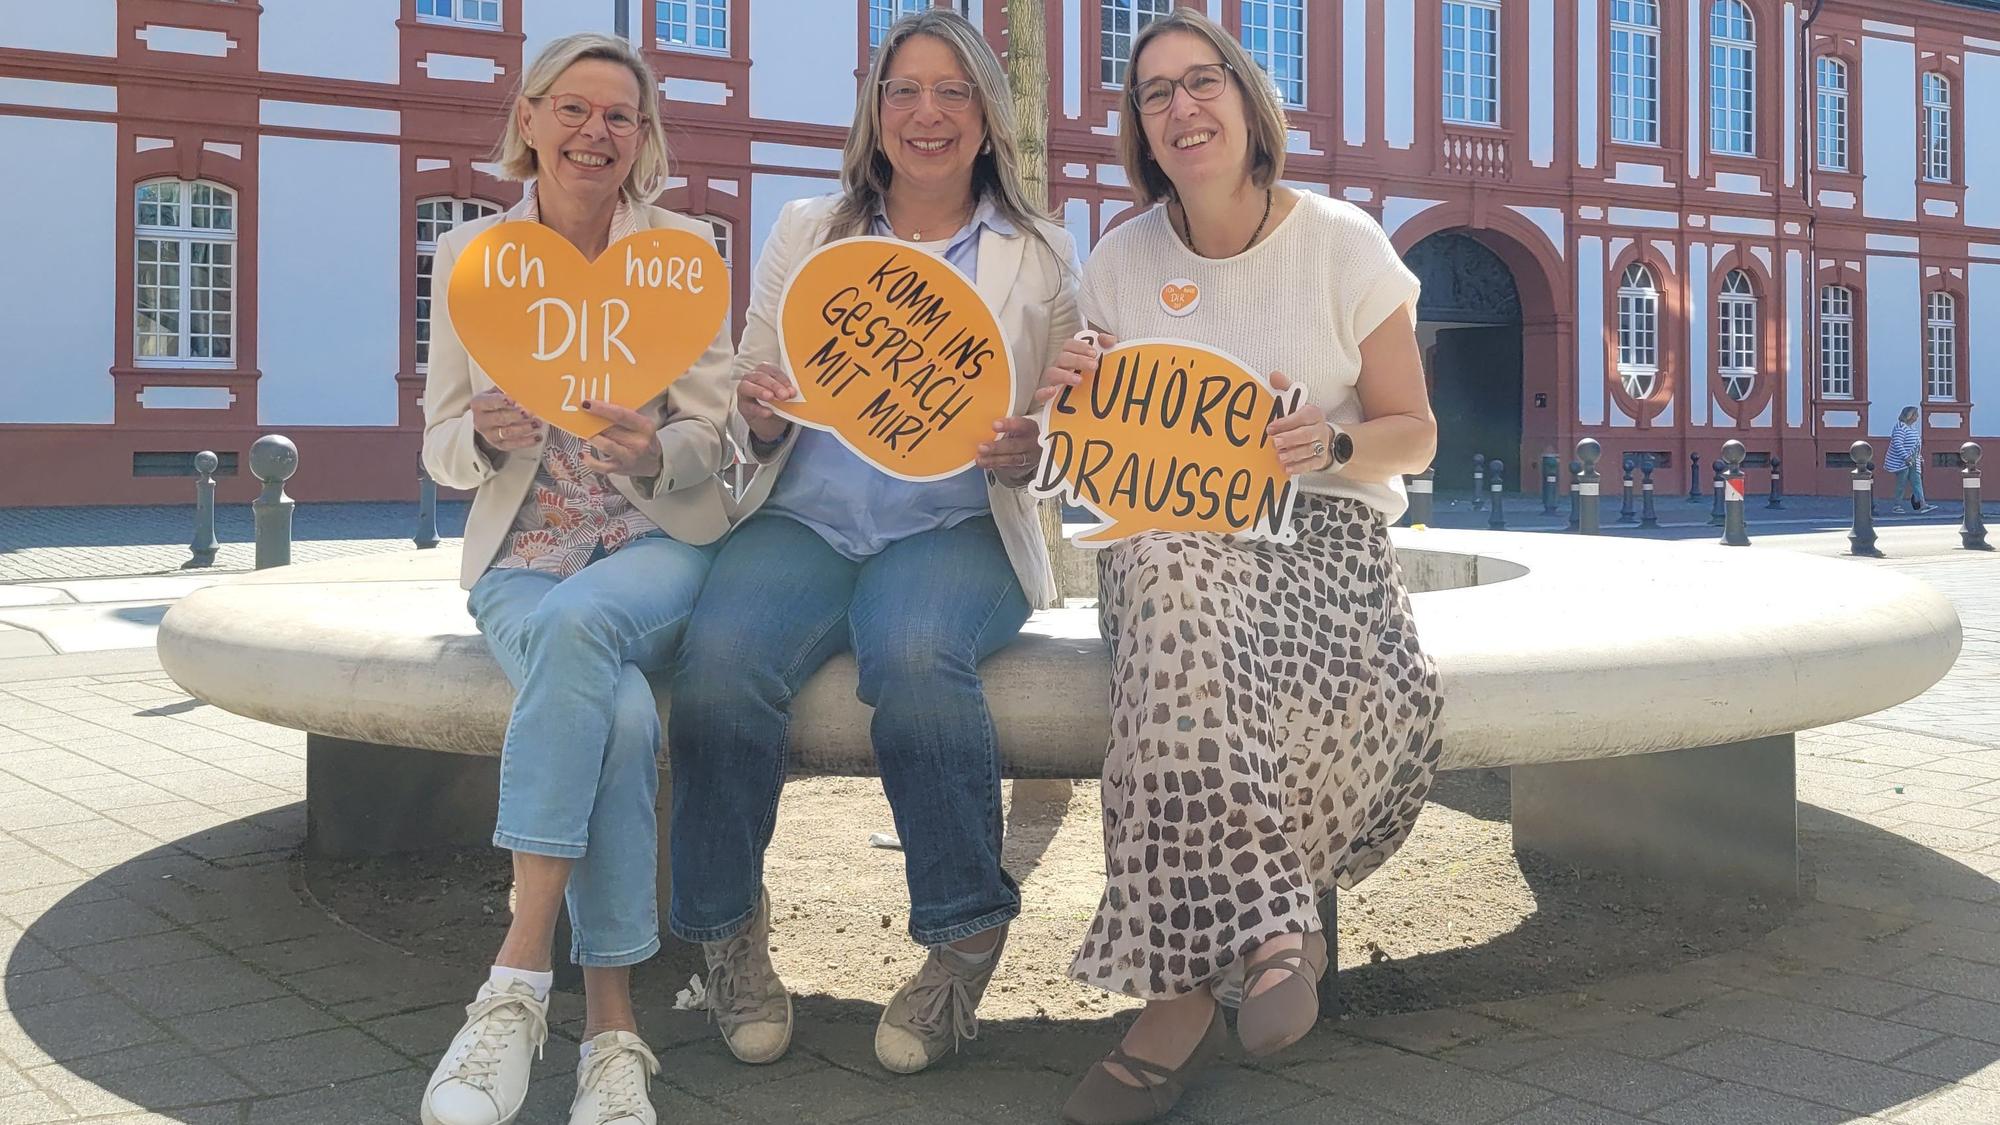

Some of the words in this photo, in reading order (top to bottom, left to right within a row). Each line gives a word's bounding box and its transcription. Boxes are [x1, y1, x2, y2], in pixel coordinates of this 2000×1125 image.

[526, 297, 636, 365] DIR
[867, 253, 952, 342] KOMM
[938, 327, 994, 380] INS
[804, 336, 871, 398] MIT
[857, 388, 932, 459] MIR!
